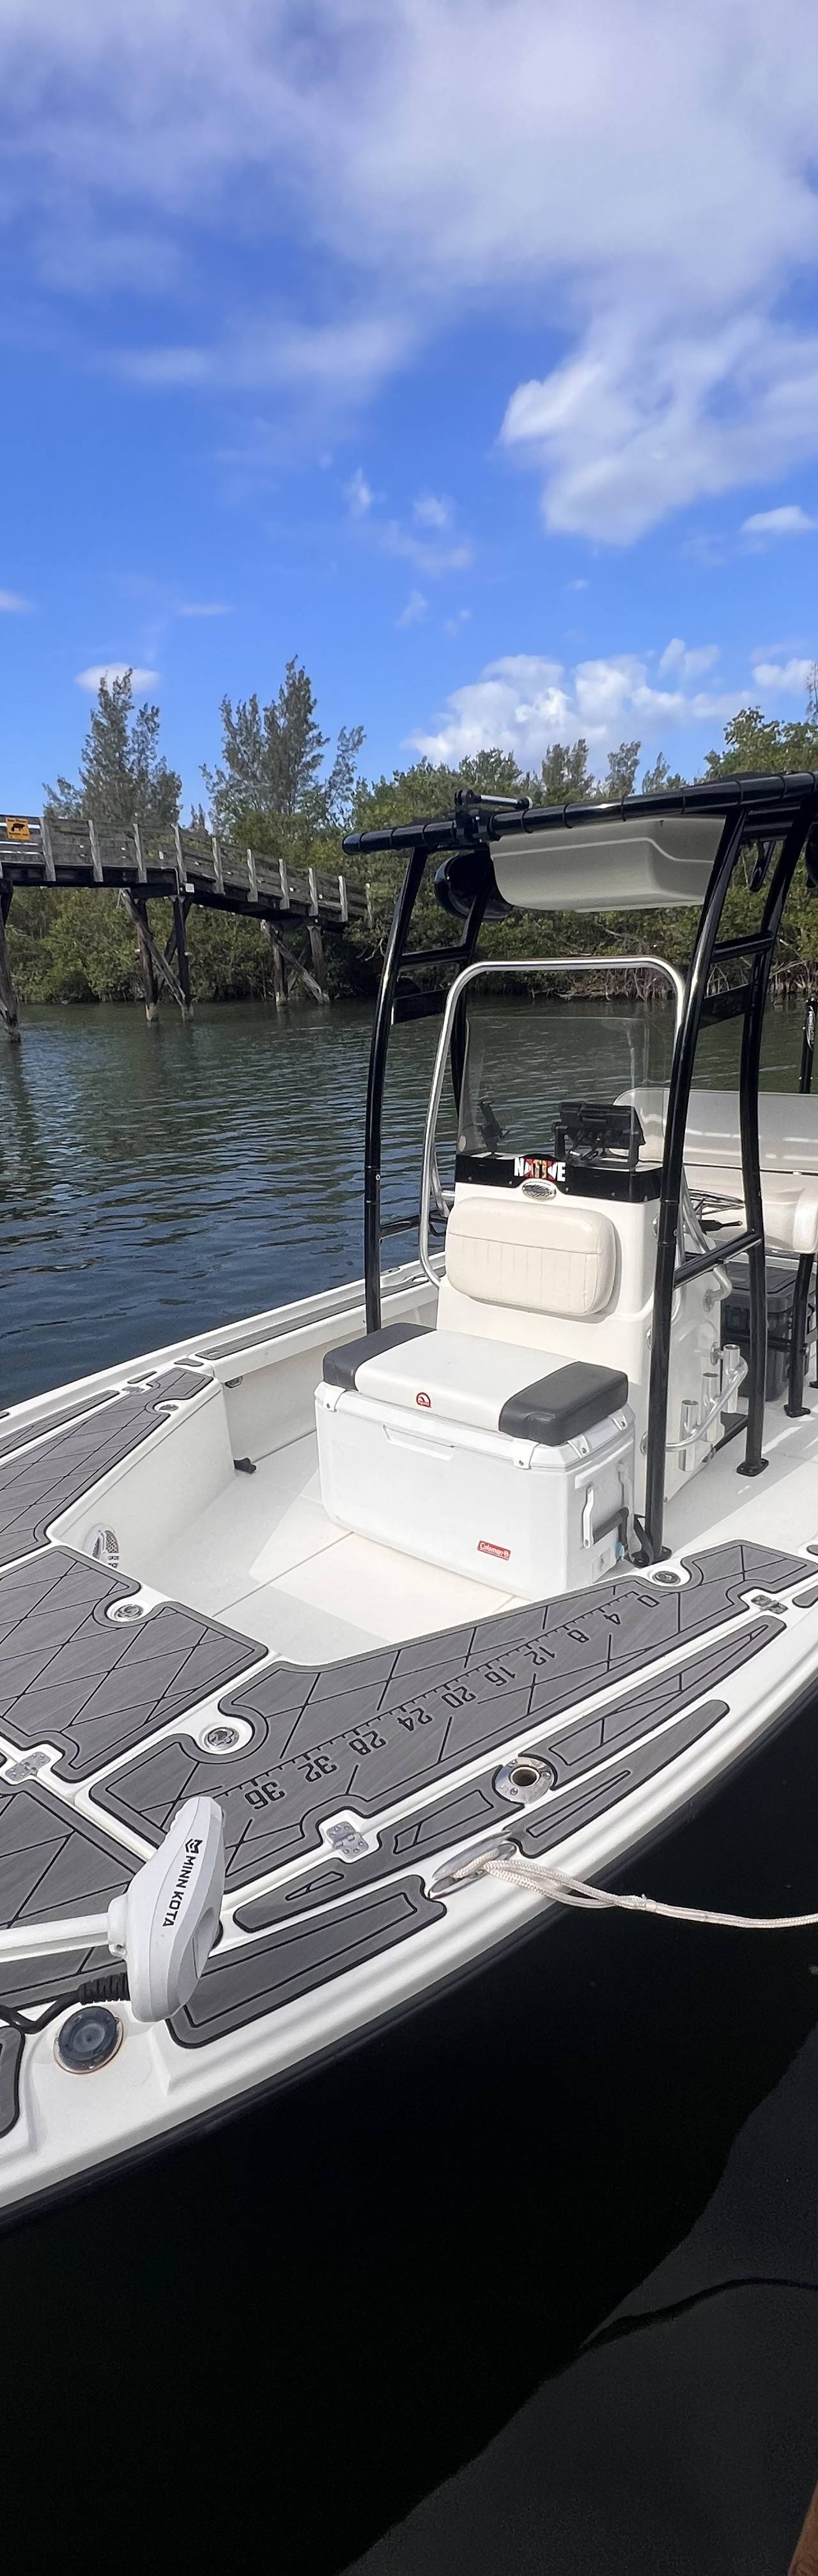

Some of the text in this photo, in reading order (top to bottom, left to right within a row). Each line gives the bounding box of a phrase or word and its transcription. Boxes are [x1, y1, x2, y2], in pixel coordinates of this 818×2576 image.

[514, 1157, 566, 1182] NATIVE
[479, 1542, 504, 1556] Coleman
[244, 1595, 660, 1810] 0 4 8 12 16 20 24 28 32 36
[162, 1855, 196, 1927] MINN KOTA
